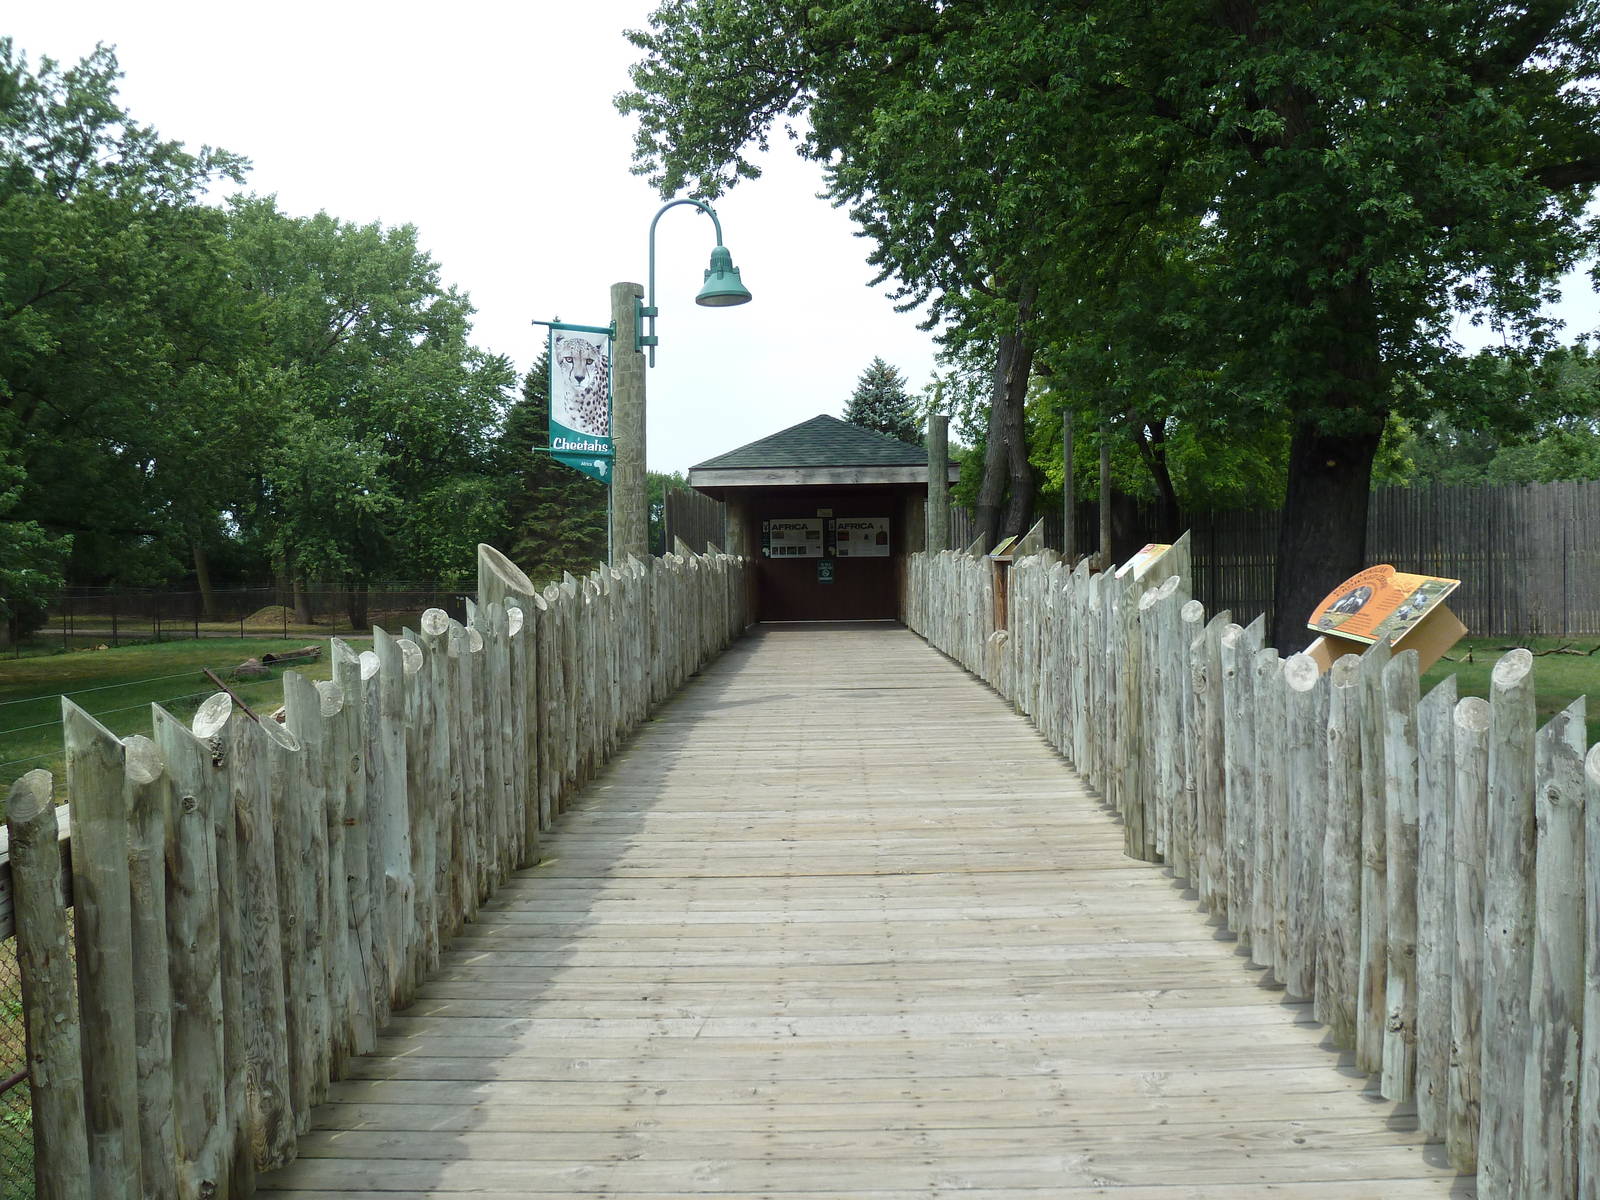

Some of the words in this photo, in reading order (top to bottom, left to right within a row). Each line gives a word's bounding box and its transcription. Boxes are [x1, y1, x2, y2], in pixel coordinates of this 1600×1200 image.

[553, 437, 608, 452] Cheetahs
[771, 523, 809, 531] AFRICA
[837, 522, 875, 530] AFRICA
